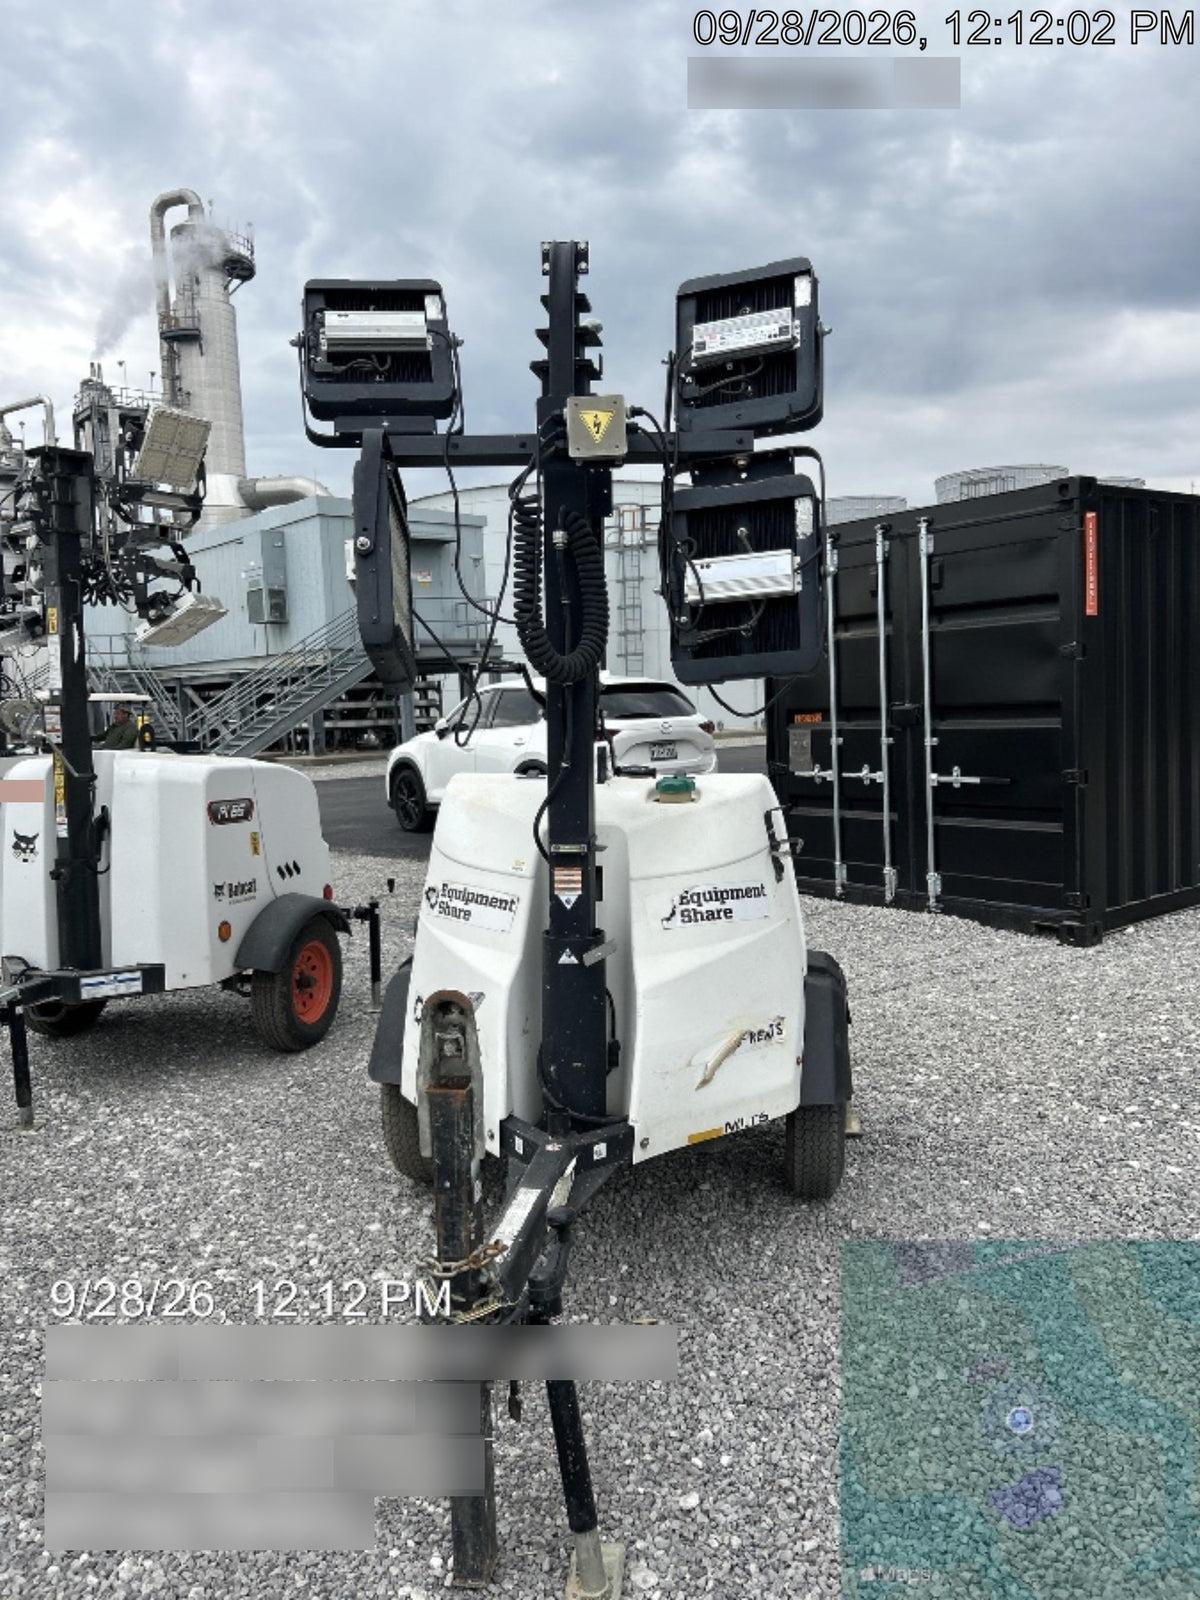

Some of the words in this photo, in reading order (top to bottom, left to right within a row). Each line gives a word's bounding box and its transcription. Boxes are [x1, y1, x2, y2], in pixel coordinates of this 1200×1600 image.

[441, 883, 517, 912] Equipment
[679, 883, 767, 907] Equipment
[439, 901, 472, 921] Share
[680, 908, 733, 923] Share
